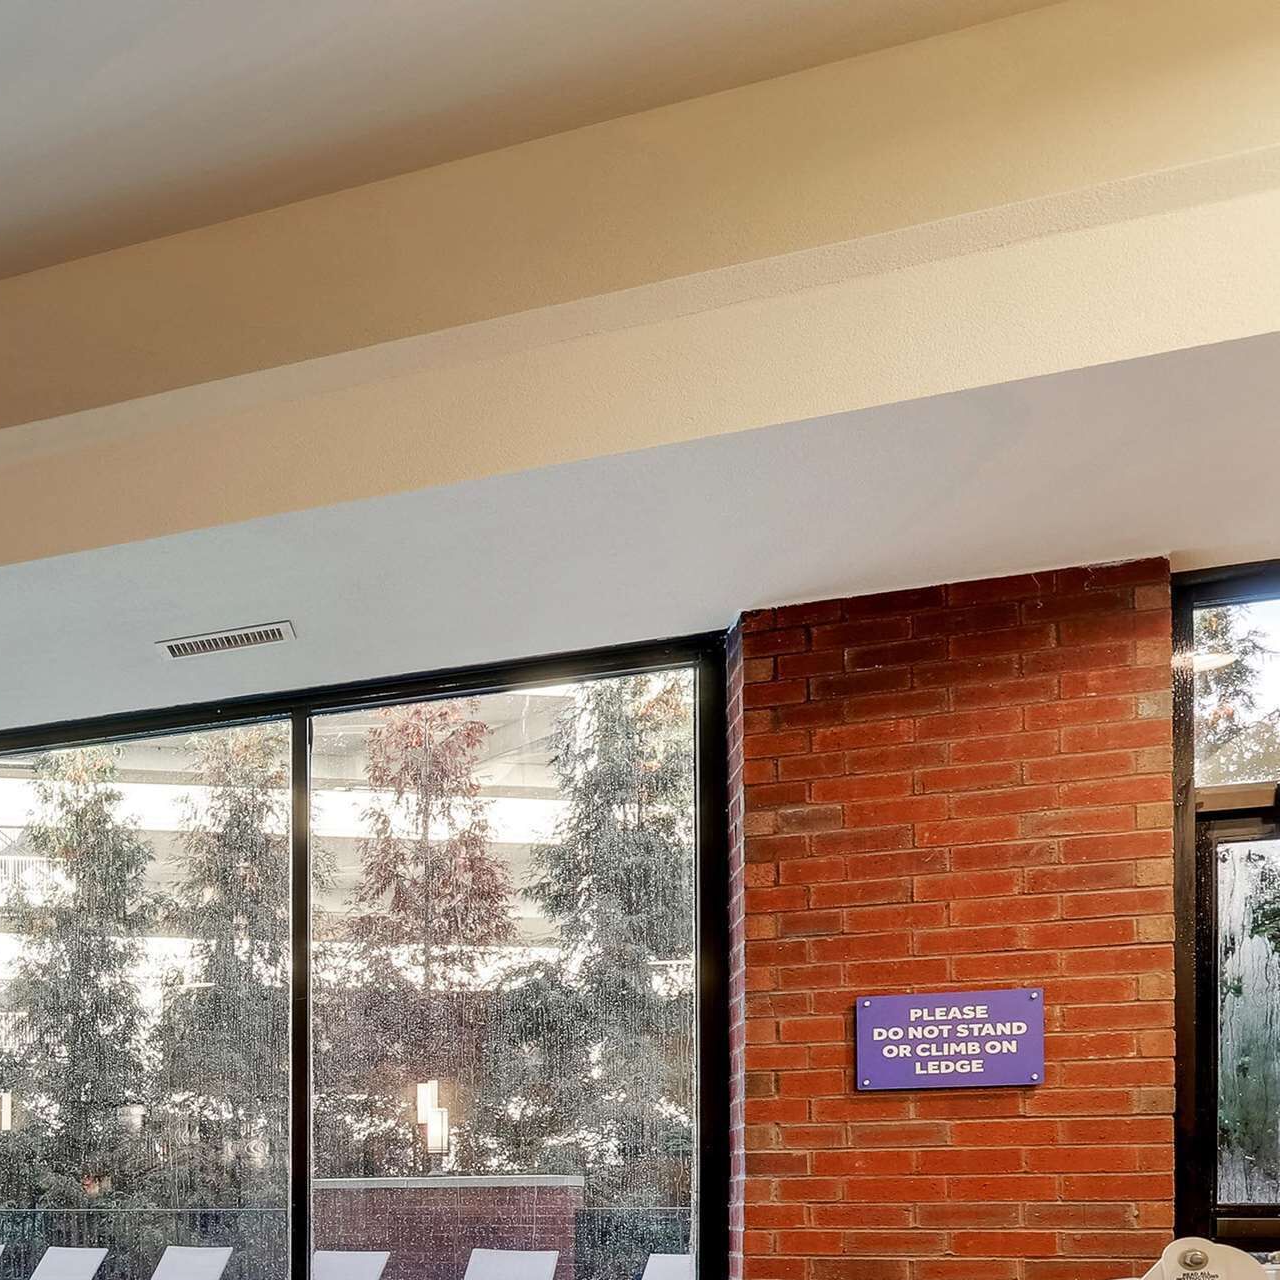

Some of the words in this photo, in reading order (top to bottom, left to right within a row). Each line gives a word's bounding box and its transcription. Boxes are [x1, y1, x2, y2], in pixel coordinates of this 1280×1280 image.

[910, 1006, 989, 1022] PLEASE
[873, 1028, 904, 1041] DO
[908, 1025, 952, 1039] NOT
[956, 1022, 1027, 1038] STAND
[882, 1045, 912, 1058] OR
[916, 1042, 981, 1057] CLIMB
[985, 1040, 1017, 1055] ON
[915, 1060, 984, 1075] LEDGE
